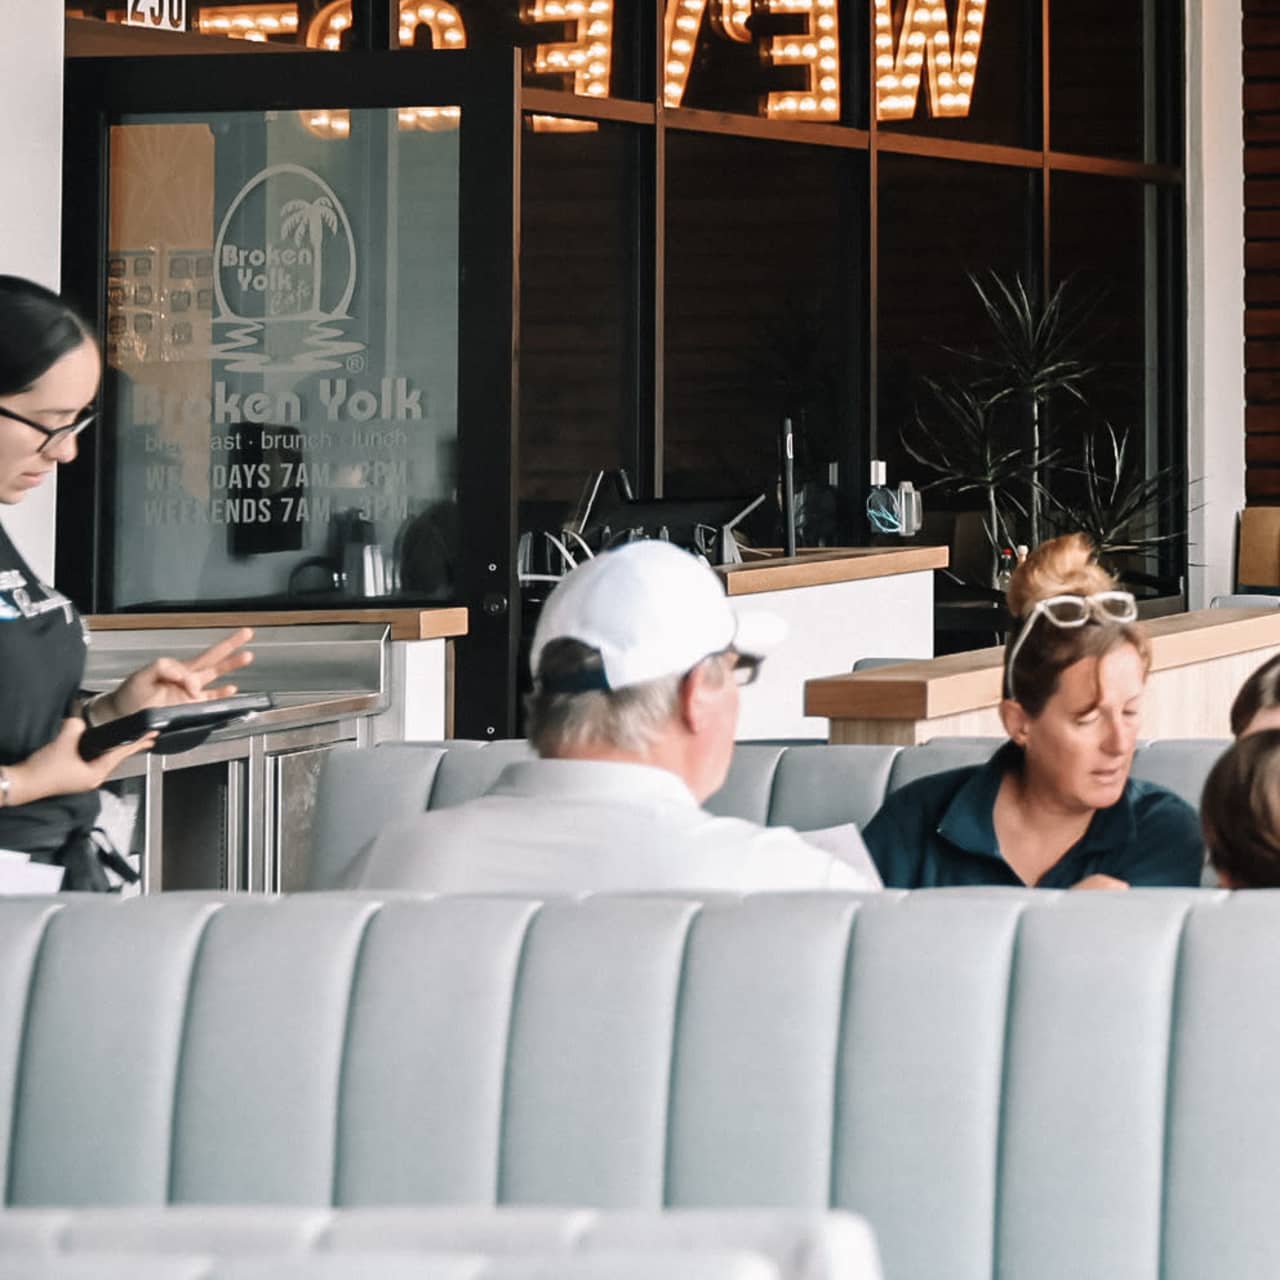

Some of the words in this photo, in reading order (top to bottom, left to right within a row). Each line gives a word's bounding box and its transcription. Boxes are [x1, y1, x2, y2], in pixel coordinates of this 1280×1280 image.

[222, 242, 313, 268] Broken
[237, 267, 292, 292] Yolk
[133, 380, 301, 425] Broken
[318, 376, 424, 422] Yolk
[145, 430, 242, 453] breast
[260, 430, 333, 450] brunch
[352, 427, 409, 449] lunch
[146, 463, 271, 491] WEDAYS
[279, 462, 330, 489] 7AM
[280, 496, 331, 523] 7AM
